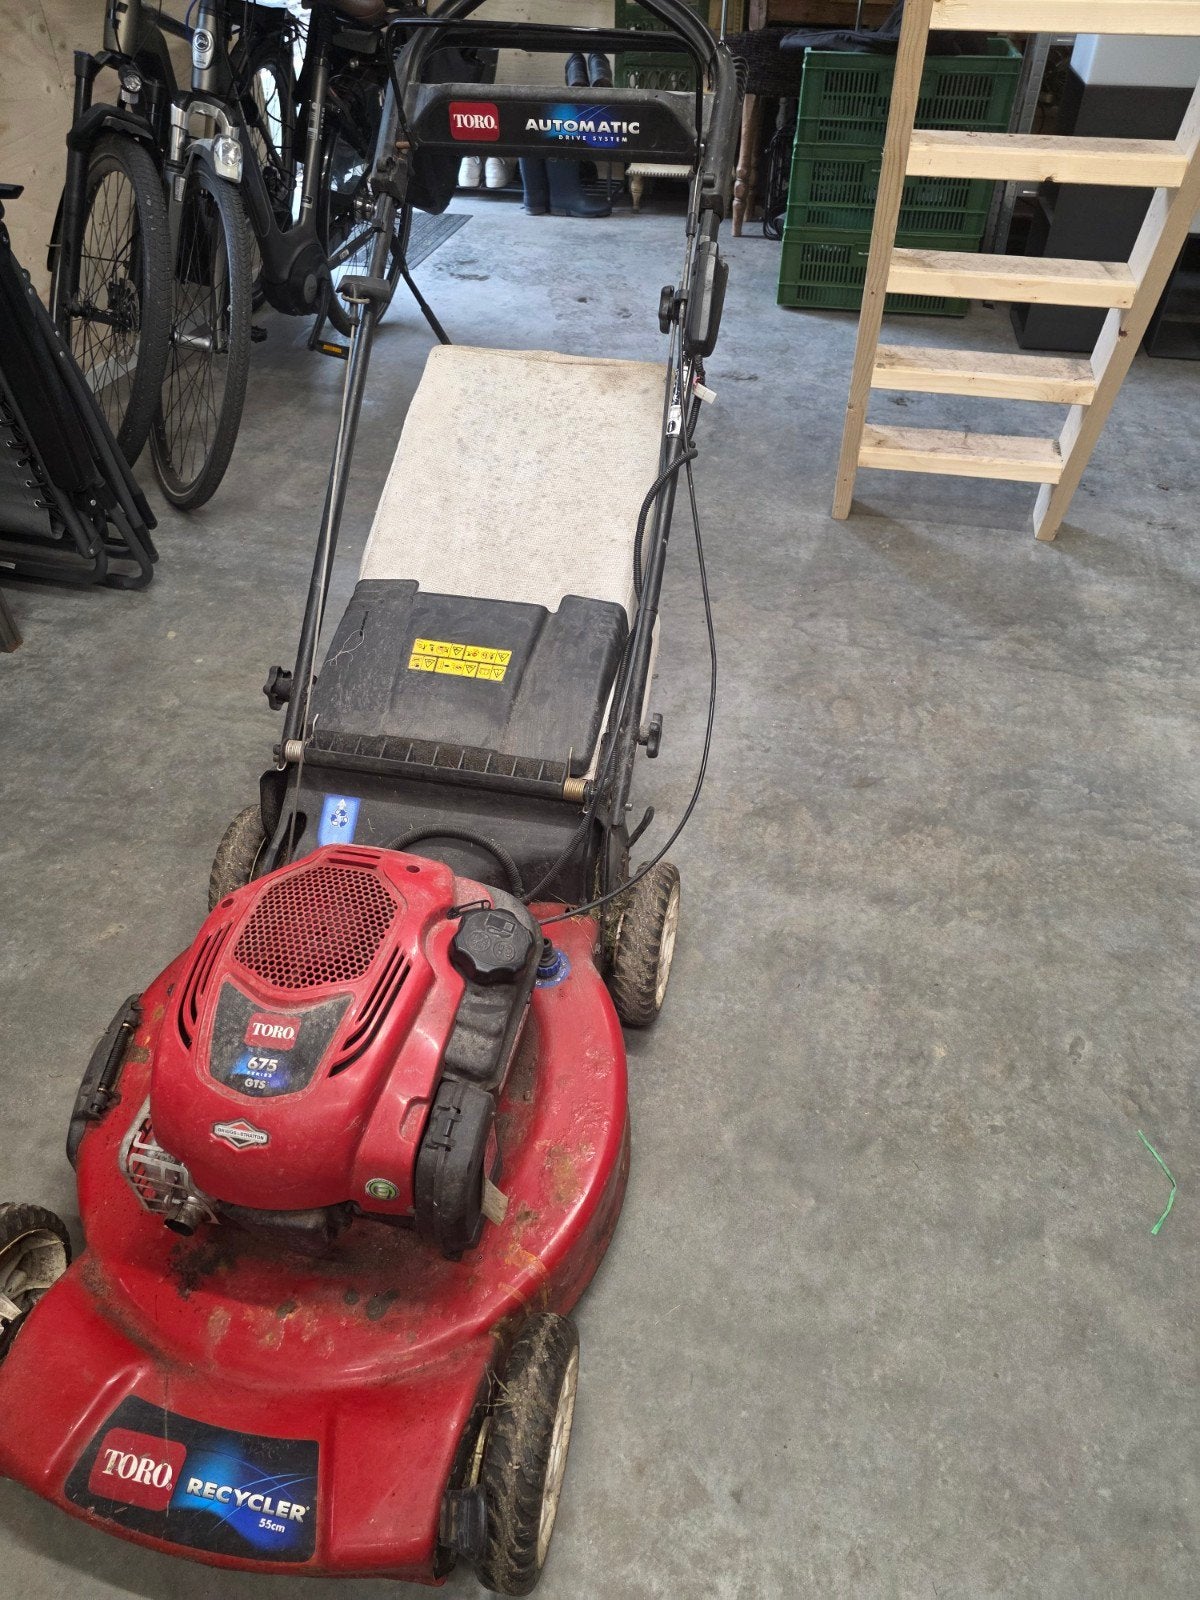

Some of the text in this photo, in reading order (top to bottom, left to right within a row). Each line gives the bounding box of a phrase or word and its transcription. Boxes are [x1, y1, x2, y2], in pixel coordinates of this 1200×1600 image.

[453, 113, 496, 130] TORO
[525, 118, 640, 135] AUTOMATIC
[558, 134, 628, 143] DRIVE SYSTEM
[252, 1022, 294, 1040] TORO
[247, 1056, 279, 1072] 675
[244, 1078, 267, 1090] GTS
[102, 1448, 172, 1489] TORO
[186, 1477, 308, 1523] RECYCLER
[258, 1518, 286, 1533] 55cm
